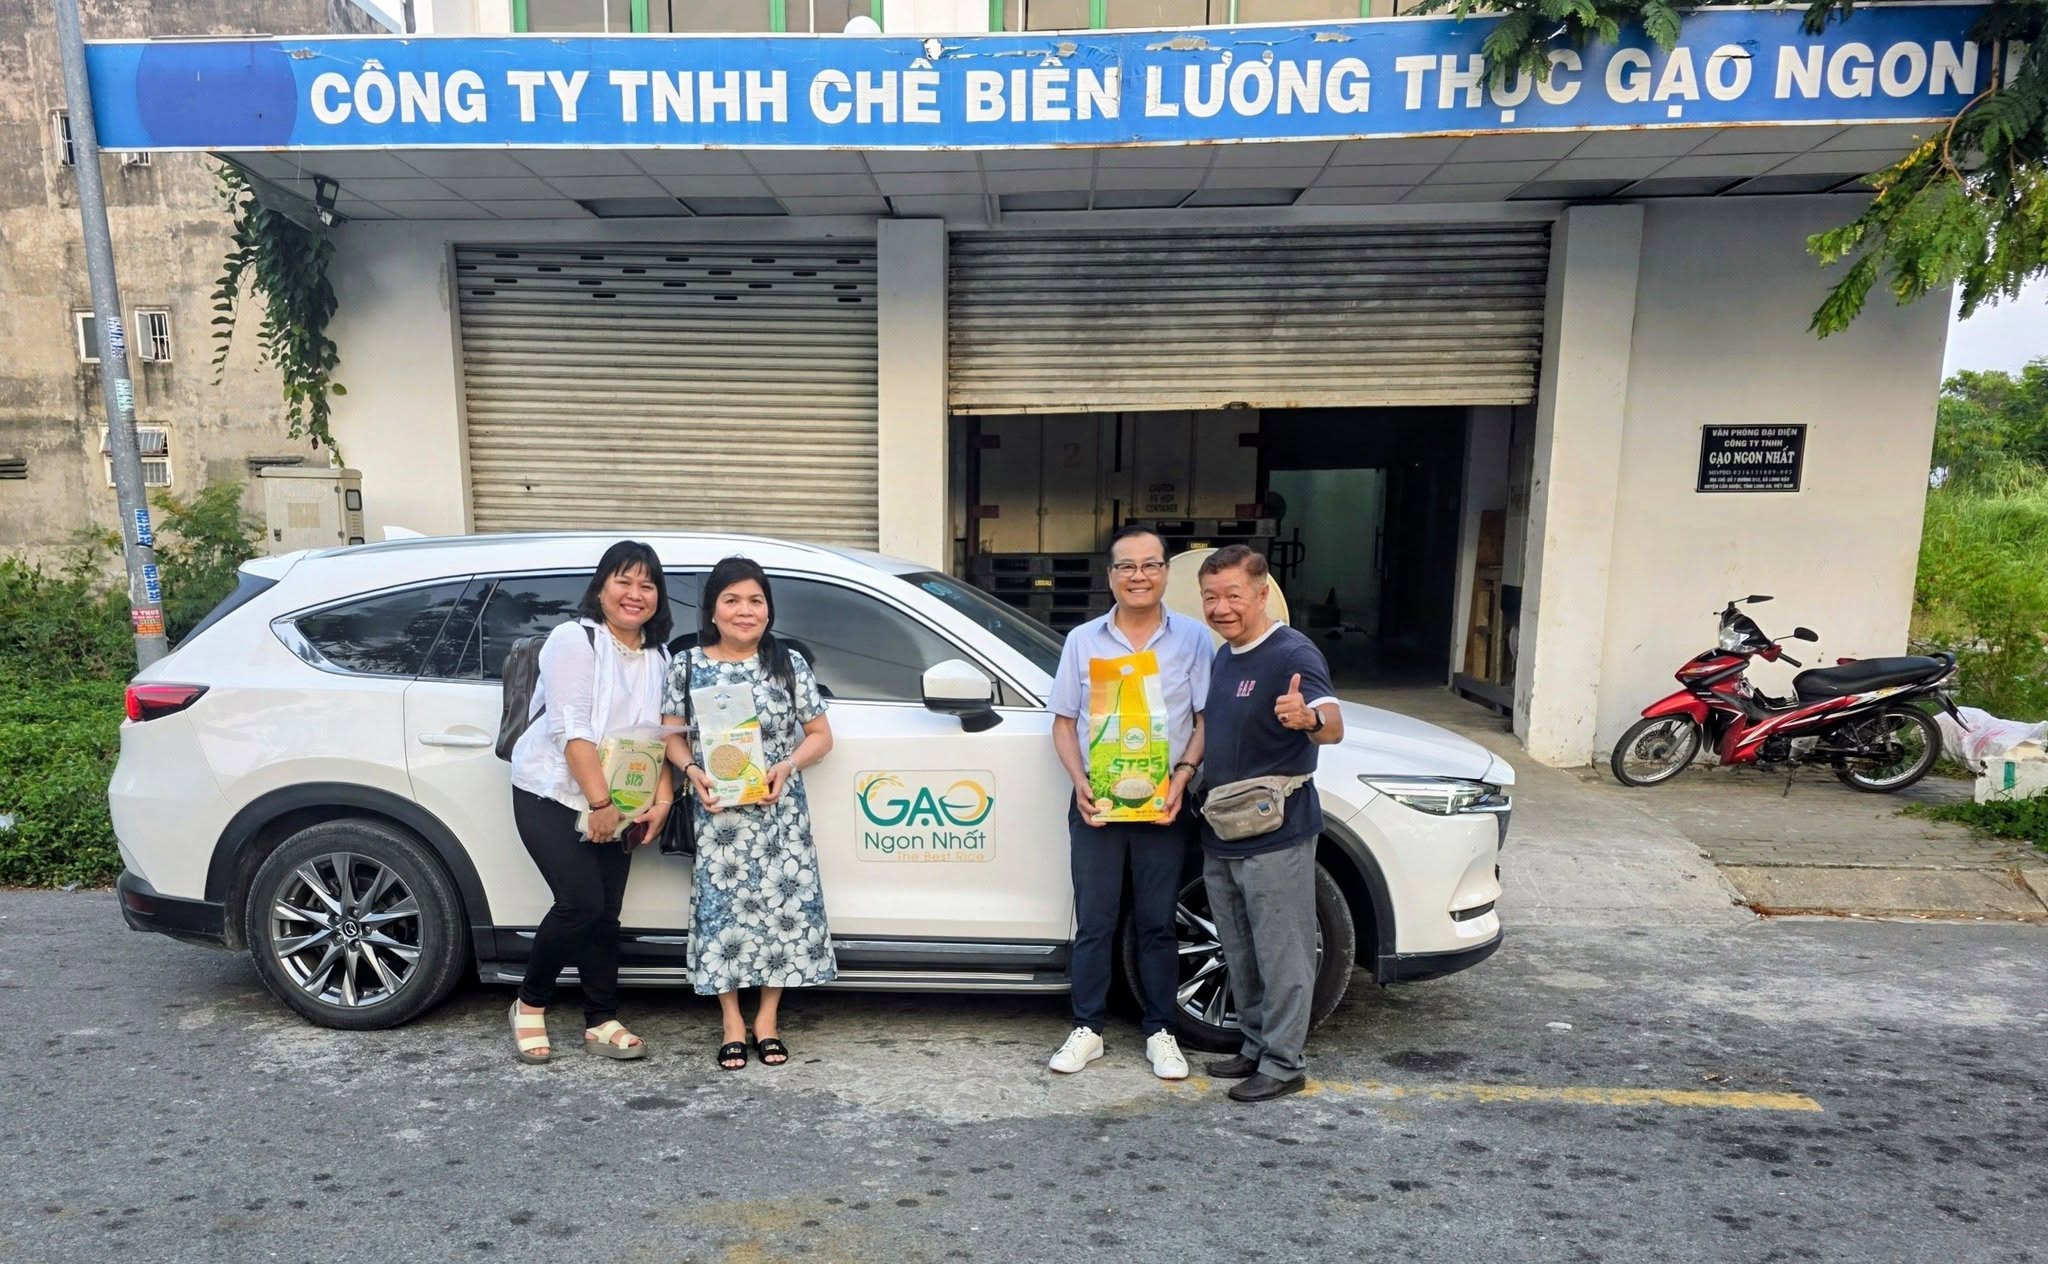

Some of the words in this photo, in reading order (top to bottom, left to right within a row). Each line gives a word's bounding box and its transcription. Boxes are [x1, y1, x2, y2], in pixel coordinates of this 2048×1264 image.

[311, 58, 487, 125] CÔNG
[507, 70, 590, 123] TY
[609, 70, 788, 123] TNHH
[1145, 49, 1371, 118] LƯƠNG
[1605, 43, 1753, 118] GẠO
[1775, 40, 1979, 99] NGON
[1749, 439, 1759, 447] TY
[1761, 439, 1783, 447] TNHH
[1709, 451, 1731, 468] GẠO
[1733, 451, 1763, 464] NGON
[1765, 445, 1795, 464] NHẤT
[1236, 679, 1257, 698] GAP
[1109, 755, 1163, 774] ST25
[625, 772, 644, 787] ST25
[856, 772, 994, 827] GẠO
[864, 831, 925, 854] Ngon
[932, 828, 987, 849] Nhất
[896, 851, 919, 863] The
[923, 851, 951, 863] Best
[955, 851, 985, 863] Rice
